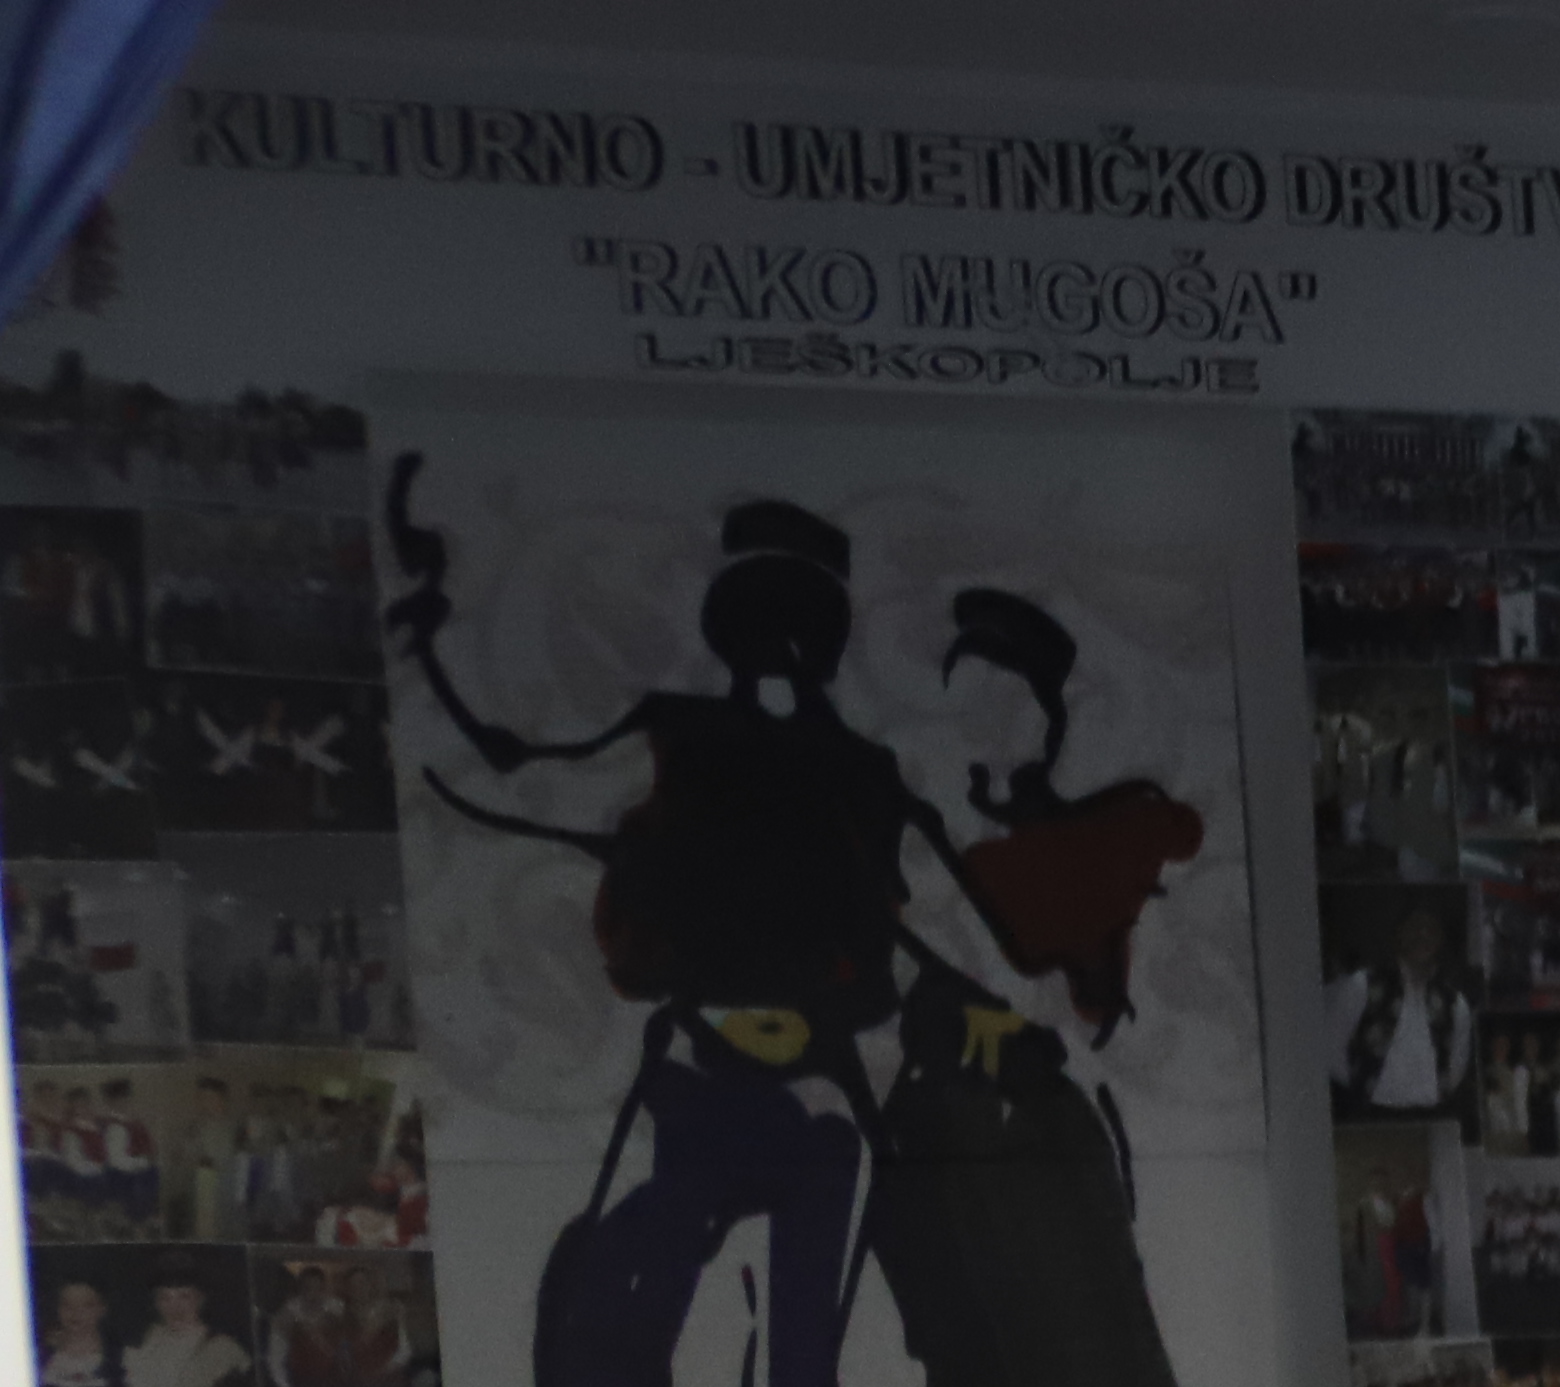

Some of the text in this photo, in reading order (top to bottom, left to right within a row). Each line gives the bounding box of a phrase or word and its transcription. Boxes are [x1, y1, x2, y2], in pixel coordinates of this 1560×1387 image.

[178, 88, 665, 192] KULTURNO
[733, 119, 1268, 225] UMJETNIČKO
[575, 235, 1319, 345] "RAKO MUGOŠA"
[634, 332, 1262, 394] LJEŠKOPOLJE
